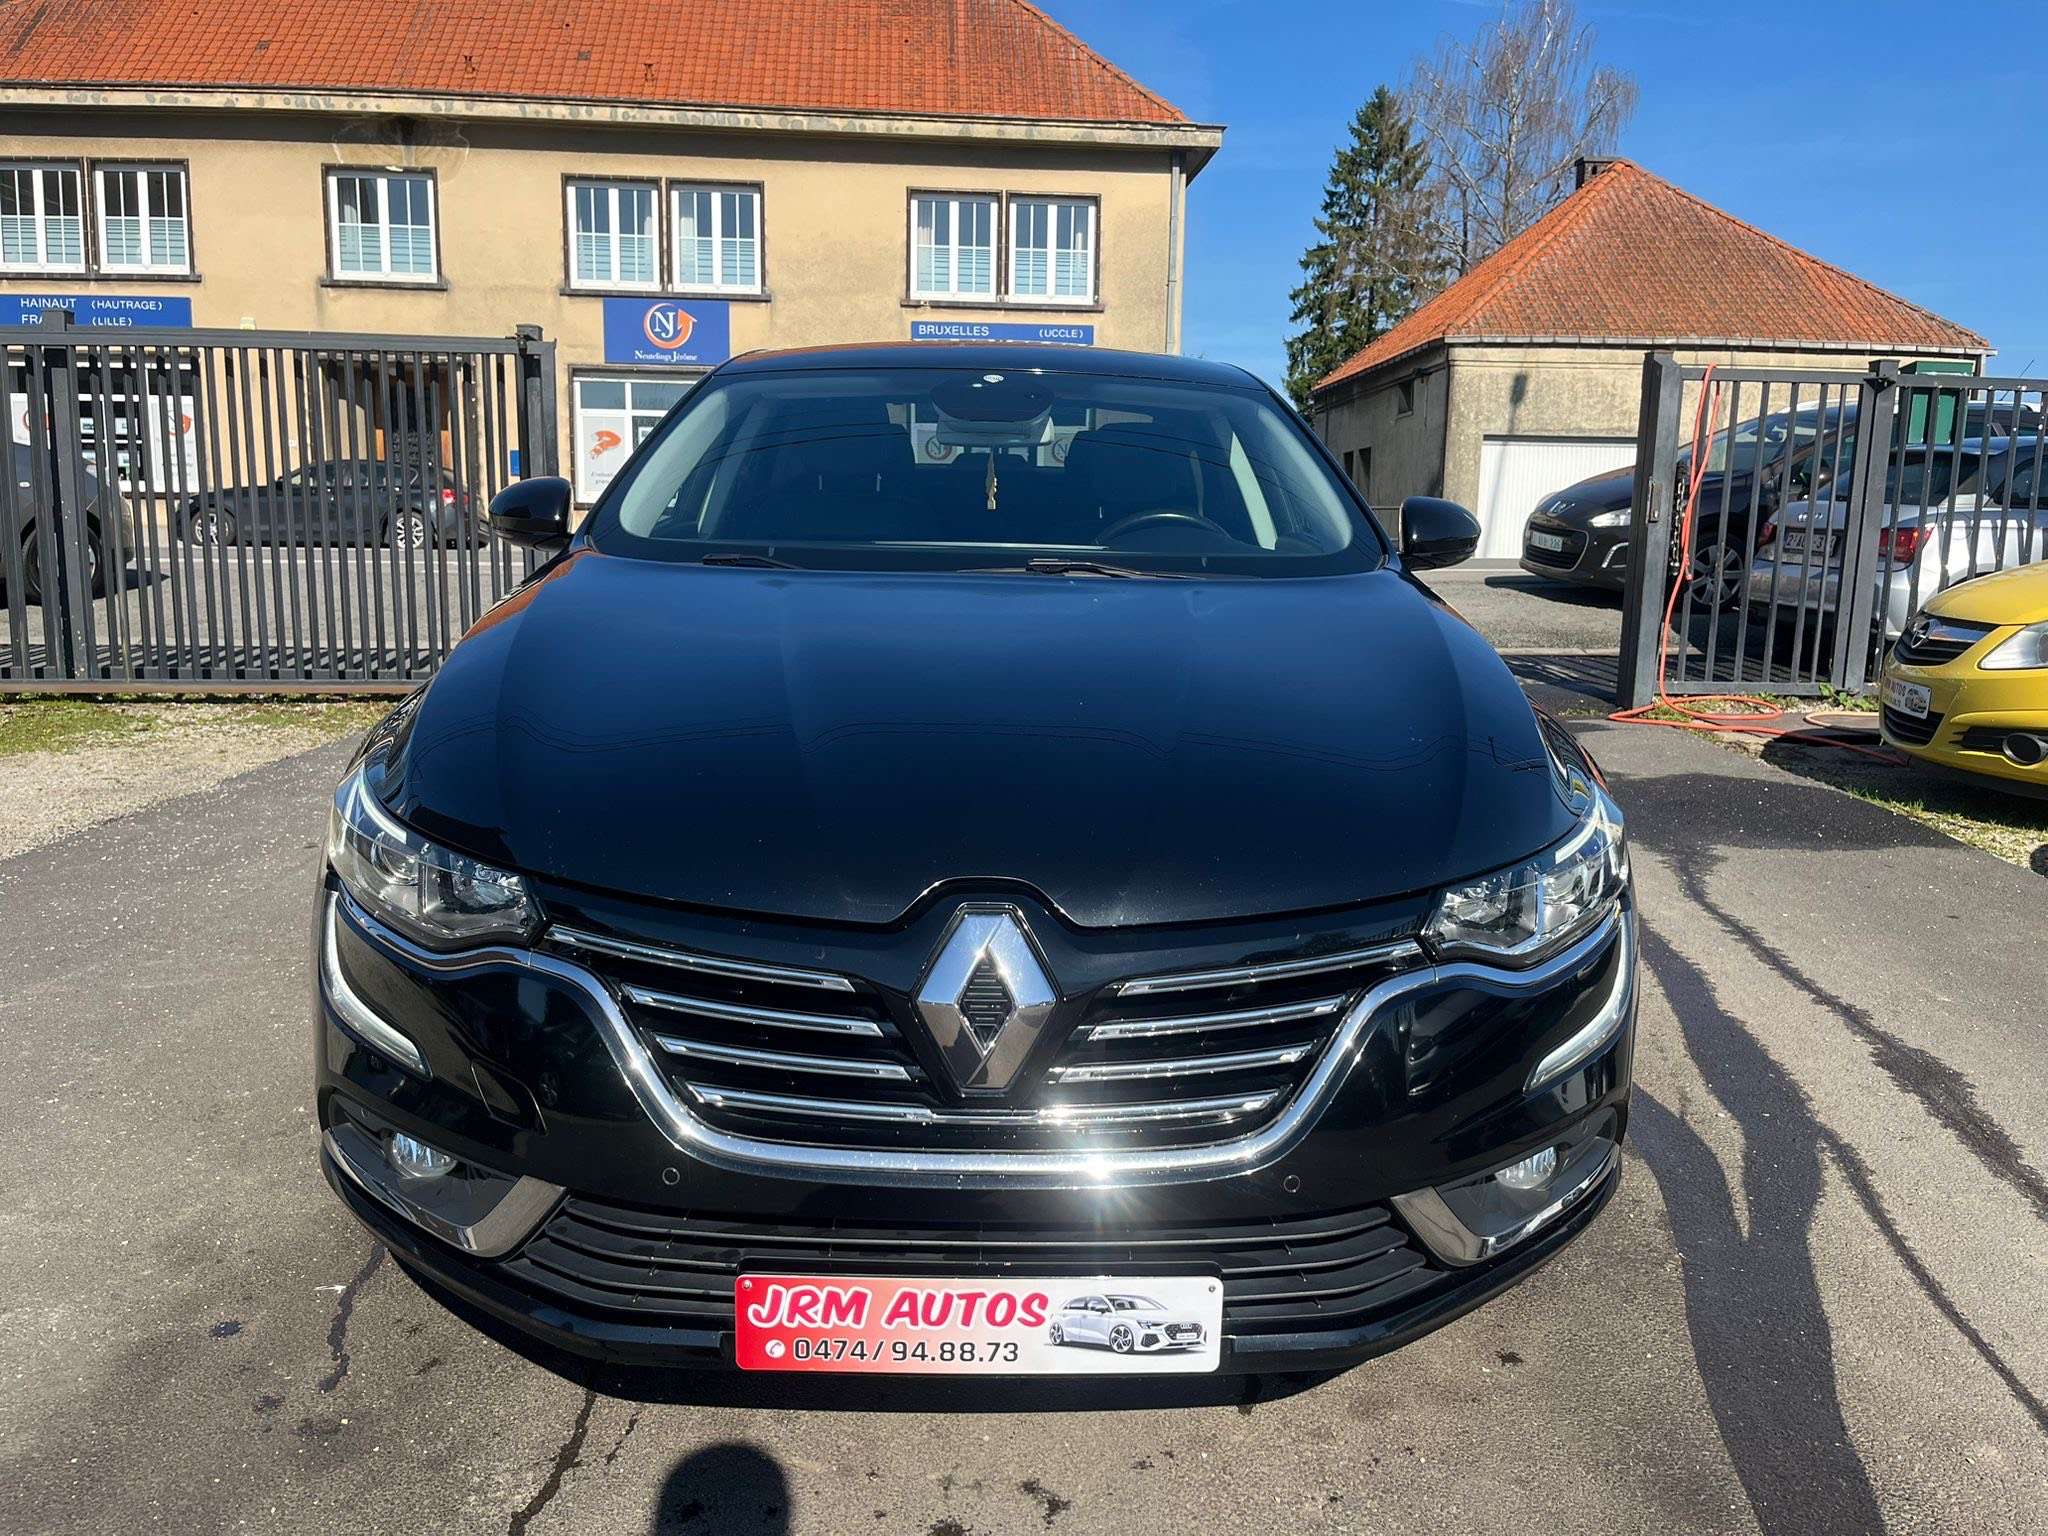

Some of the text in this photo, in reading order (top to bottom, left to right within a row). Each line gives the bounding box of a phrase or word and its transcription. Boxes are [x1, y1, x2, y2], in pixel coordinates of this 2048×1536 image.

[20, 297, 163, 311] HAINAUT (HAUTRAGE)
[92, 316, 132, 327] (LILLE)
[918, 324, 1084, 339] BRUXELLES (UCCLE)
[748, 1285, 1051, 1331] JRM AUTOS
